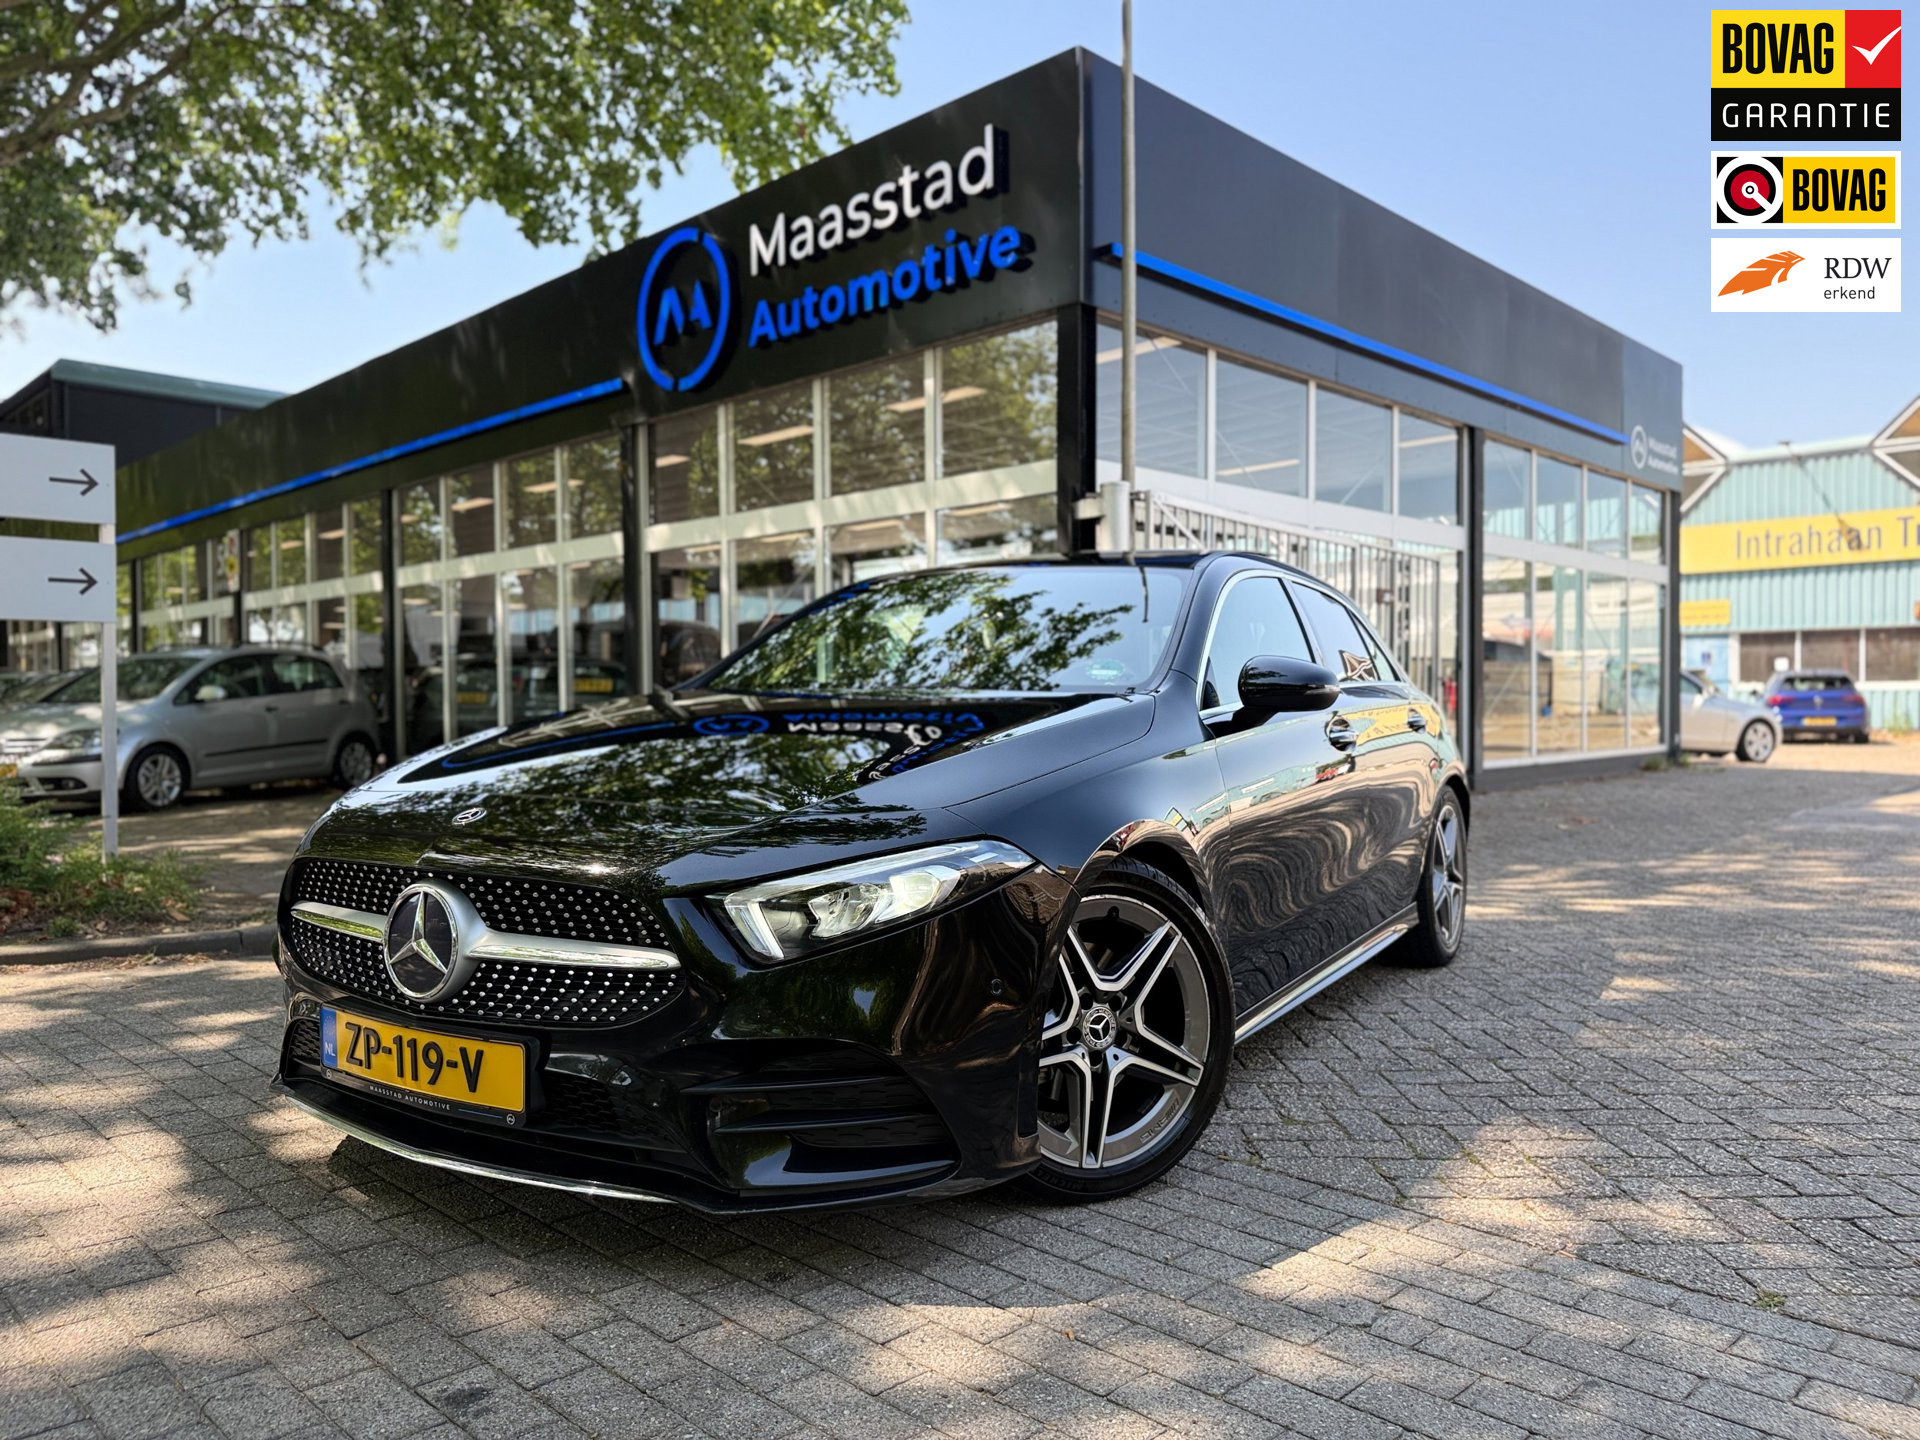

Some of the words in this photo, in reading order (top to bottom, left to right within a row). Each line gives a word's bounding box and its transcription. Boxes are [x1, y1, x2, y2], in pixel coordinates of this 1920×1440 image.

[748, 123, 995, 277] Maasstad
[748, 225, 1021, 349] Automotive
[1736, 524, 1882, 560] Intrahaan
[324, 1041, 336, 1057] NL
[345, 1021, 485, 1094] ZP-119-V
[369, 1085, 402, 1099] MAASSTAD
[404, 1095, 451, 1111] AUTOMOTIVE
